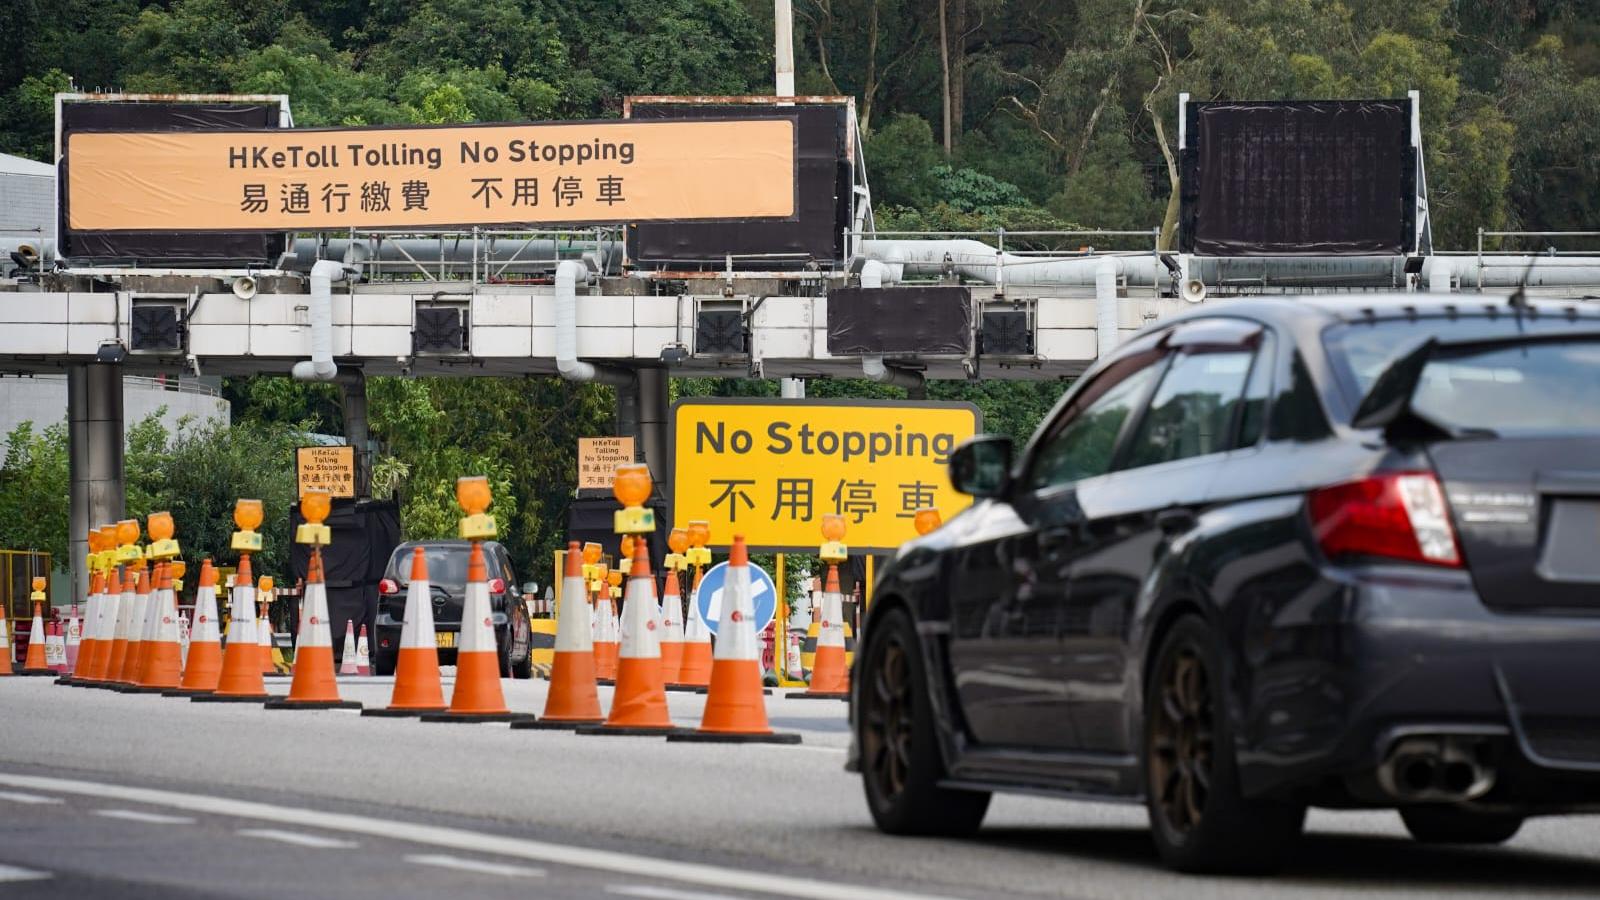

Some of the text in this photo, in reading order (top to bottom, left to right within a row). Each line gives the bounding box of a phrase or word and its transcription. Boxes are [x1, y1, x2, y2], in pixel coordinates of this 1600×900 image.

[229, 138, 635, 170] HKeToll Tolling No Stopping
[240, 174, 626, 214] 易通行繳費 不用停車
[592, 439, 620, 447] HKeToll
[695, 421, 954, 464] No Stopping
[595, 447, 619, 455] Tolling
[314, 456, 338, 464] Tolling
[597, 455, 629, 463] Stopping
[316, 464, 349, 472] Stopping
[709, 478, 938, 523] 不用停車
